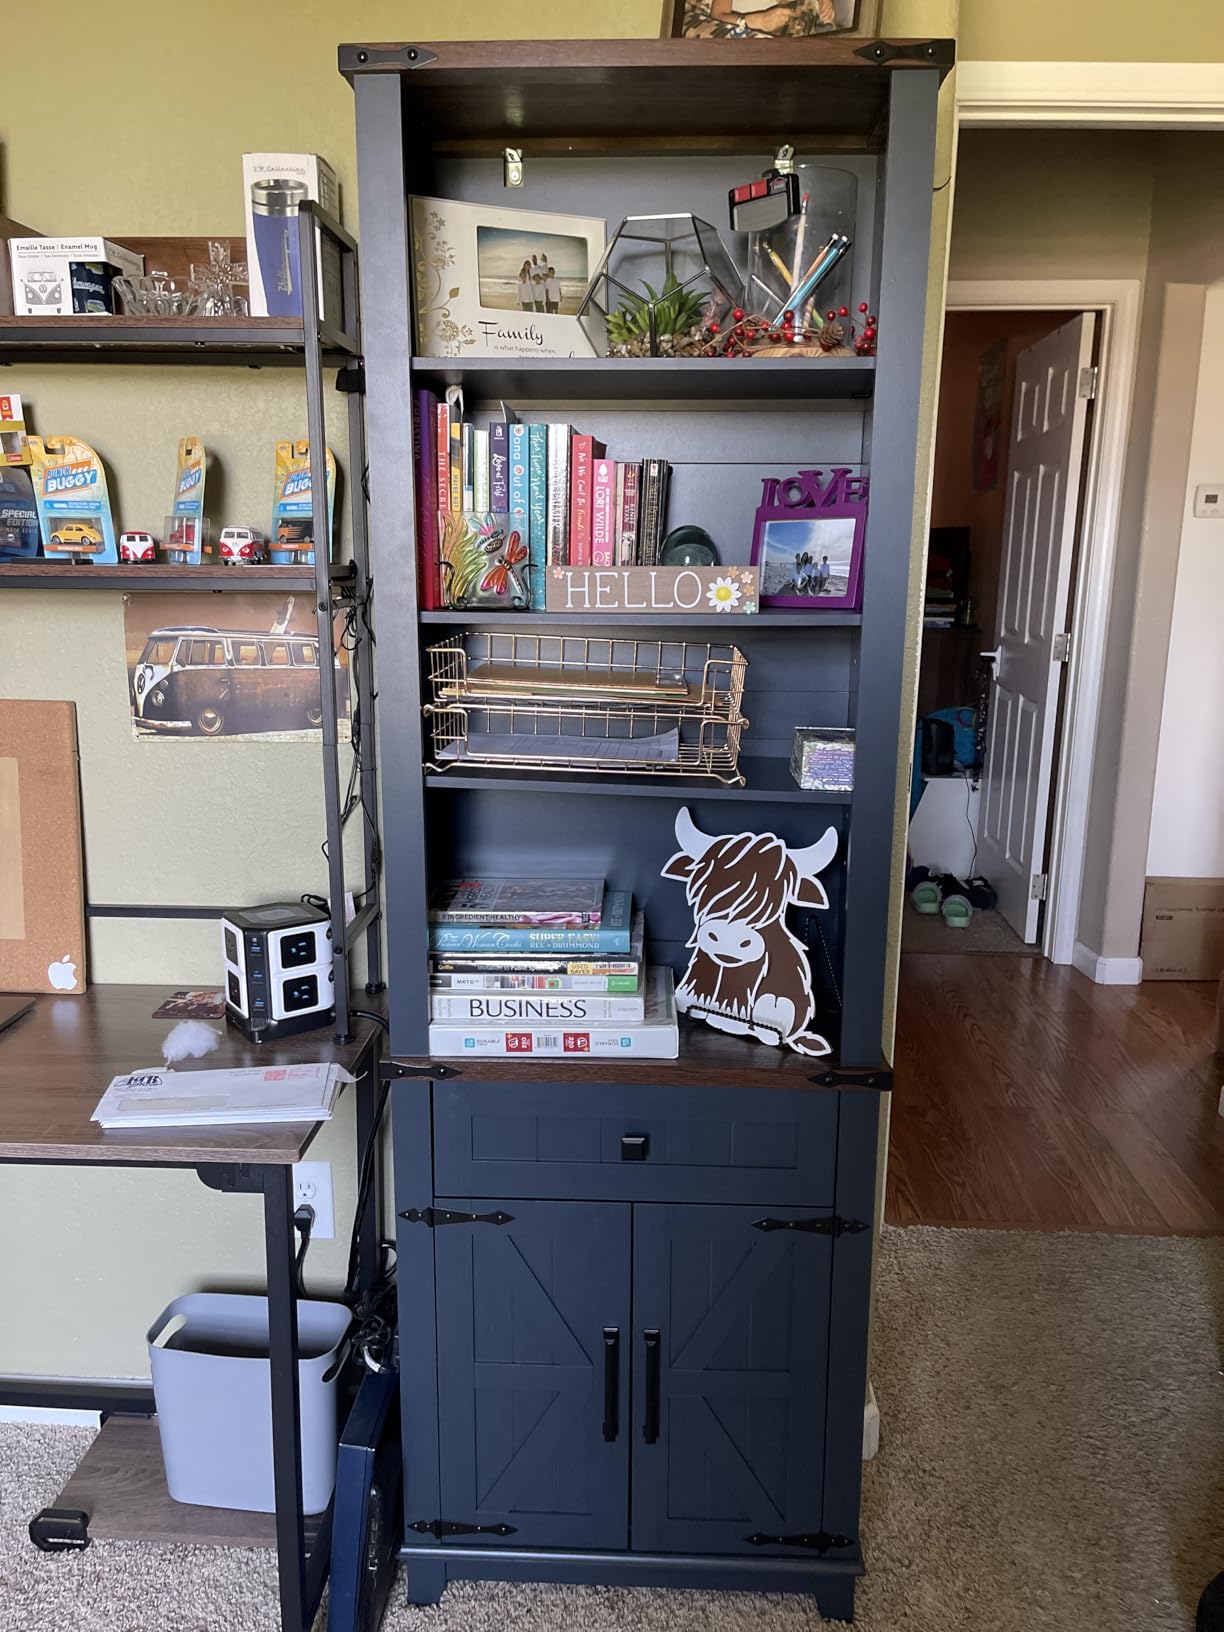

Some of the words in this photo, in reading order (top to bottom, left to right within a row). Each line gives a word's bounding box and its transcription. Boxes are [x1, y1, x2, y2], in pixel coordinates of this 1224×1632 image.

[84, 243, 98, 251] Mug
[477, 320, 544, 347] Family
[514, 345, 539, 353] happens
[512, 425, 525, 460] Oona
[531, 431, 545, 451] This
[438, 451, 447, 471] THE
[492, 453, 507, 471] Love
[532, 453, 545, 475] Time
[577, 465, 586, 477] We
[47, 470, 97, 492] BUGGY
[452, 474, 460, 495] MAYBE
[512, 464, 525, 487] Out
[285, 476, 313, 496] BUG
[438, 477, 447, 509] SECRE
[493, 480, 506, 497] First
[530, 477, 543, 499] Next
[761, 467, 869, 508] LOVE
[512, 491, 525, 504] of
[595, 486, 605, 508] LORI
[1, 508, 37, 519] SPECIAL
[7, 518, 39, 527] EDITION
[530, 502, 545, 526] Year
[594, 511, 605, 544] WILDE
[565, 571, 702, 609] HELLO
[461, 932, 495, 948] Woman
[493, 932, 522, 948] Cooks
[529, 933, 565, 942] SUPER
[469, 999, 587, 1018] BUSINESS
